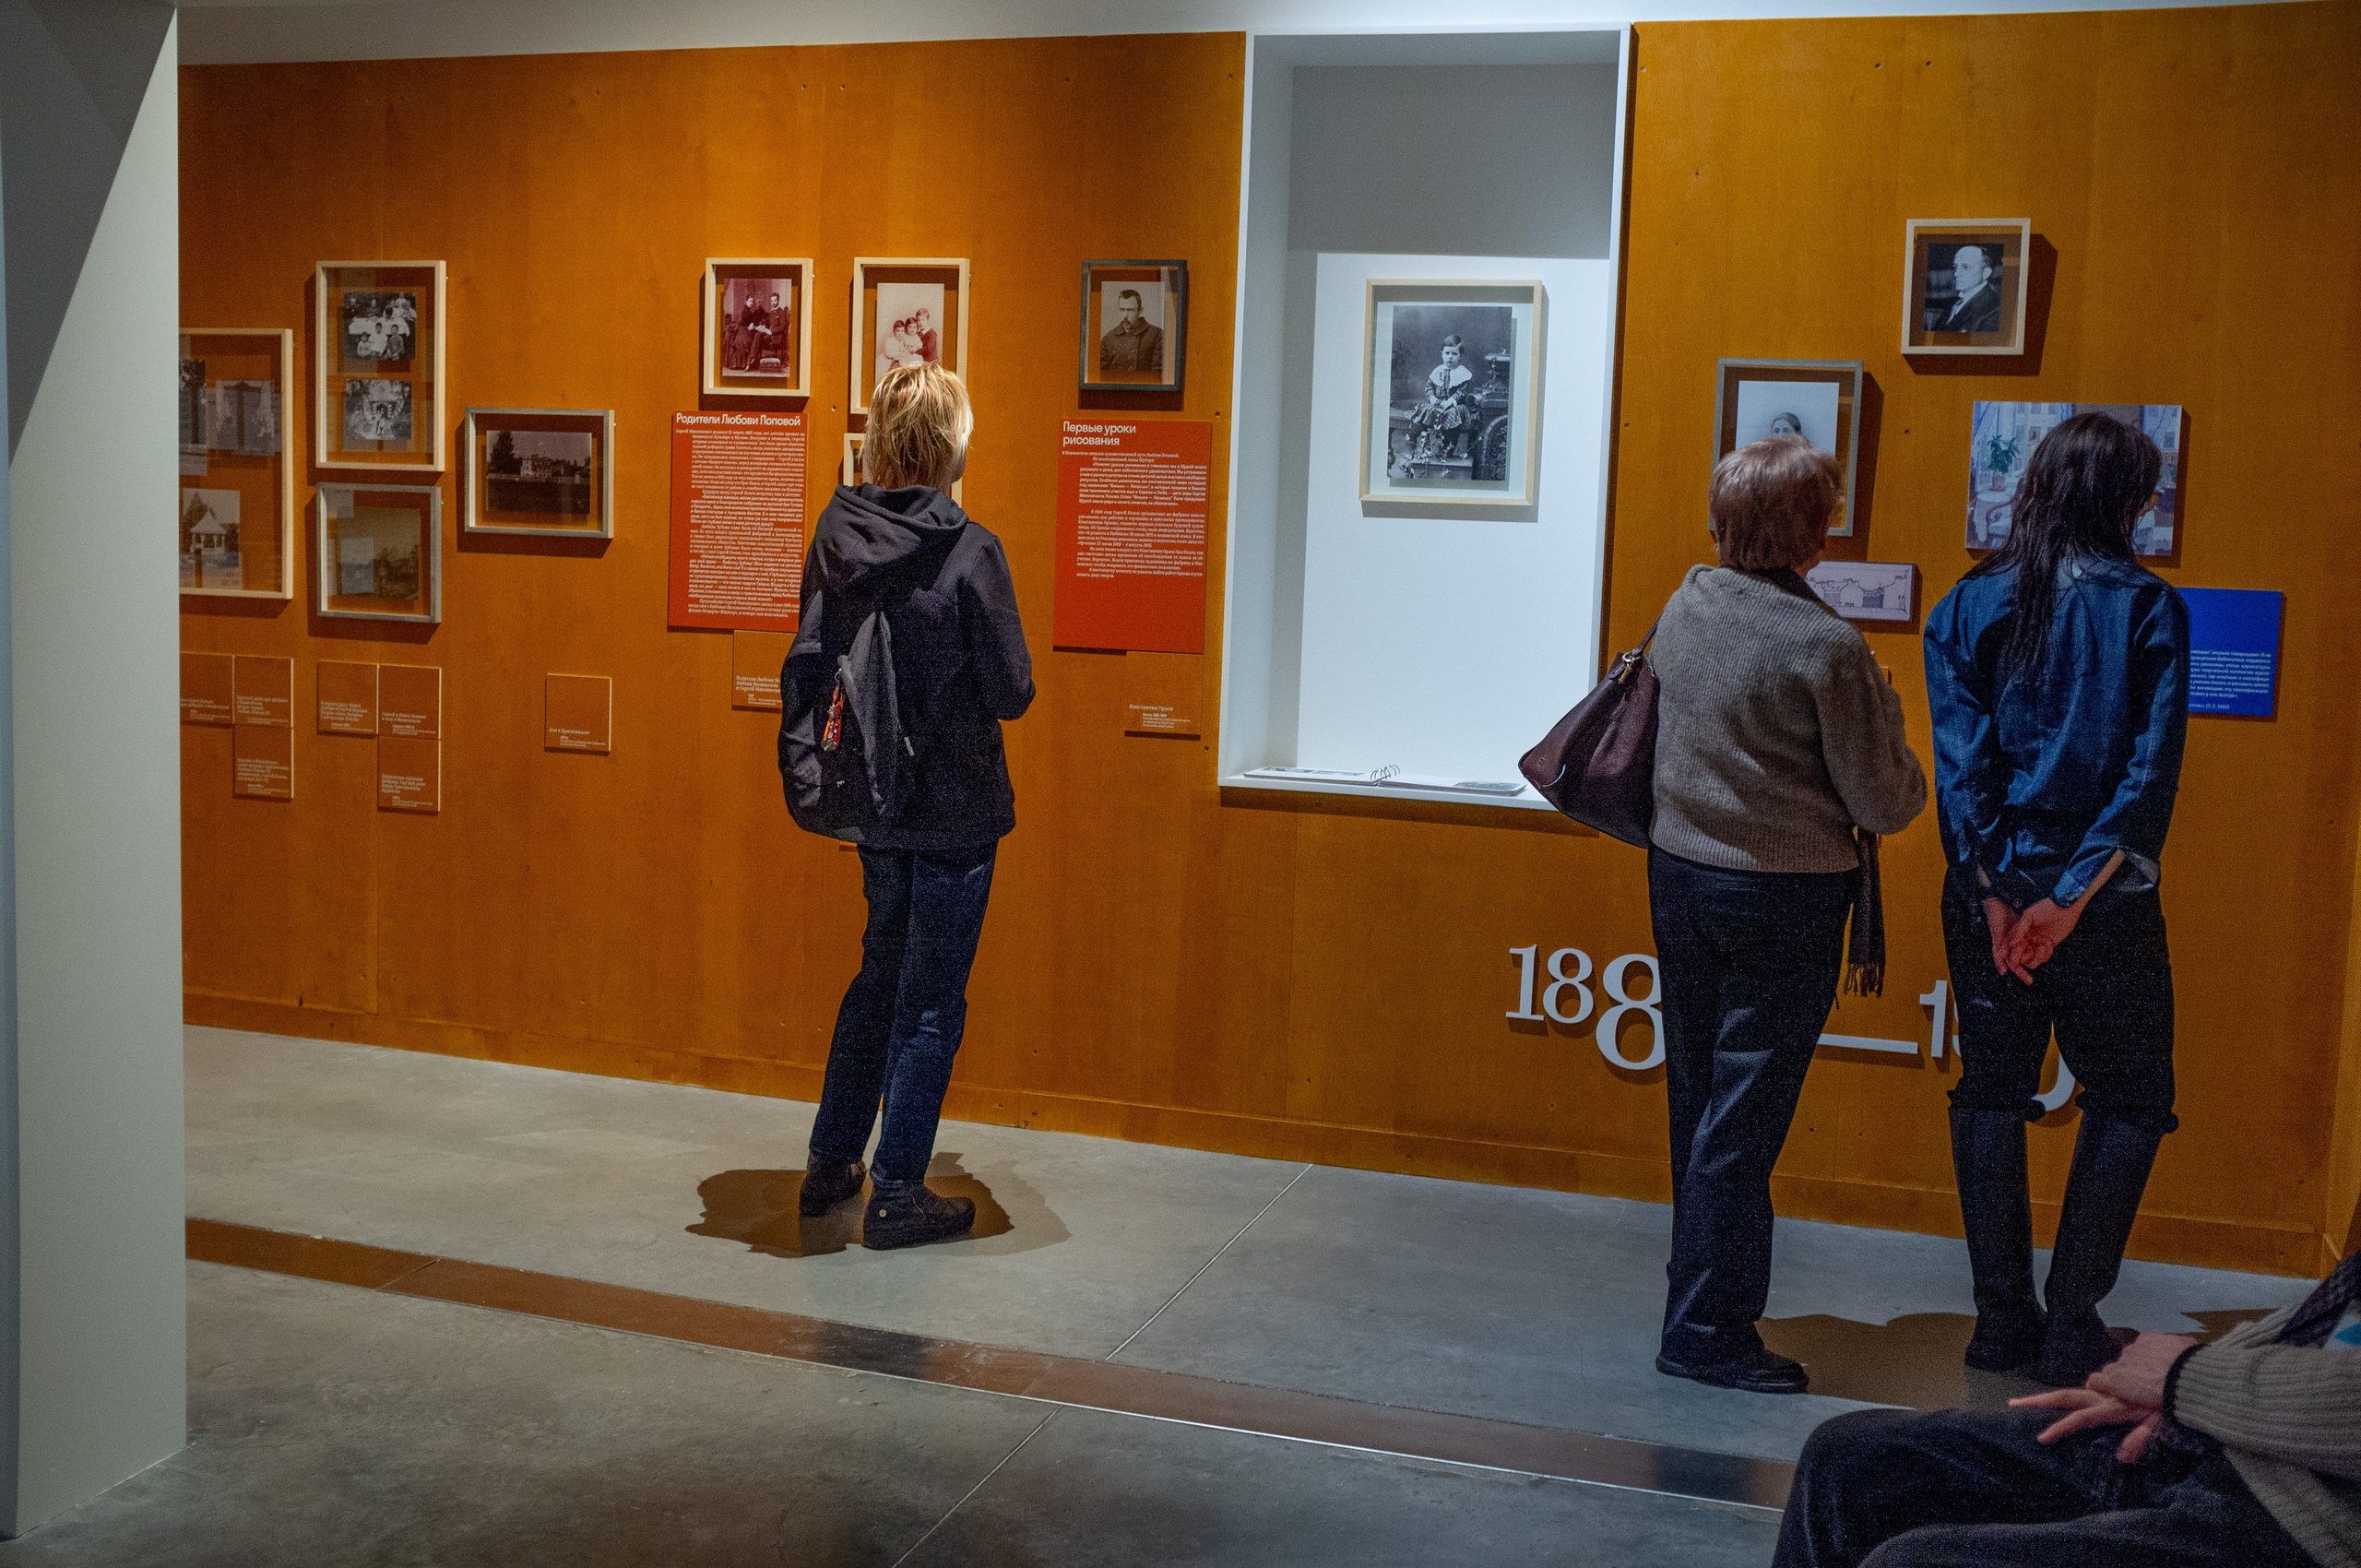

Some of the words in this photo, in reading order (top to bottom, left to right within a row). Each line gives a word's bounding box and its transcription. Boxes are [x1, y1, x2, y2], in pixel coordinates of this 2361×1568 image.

[676, 412, 721, 424] Родители
[721, 413, 759, 425] Любови
[760, 415, 801, 426] Поповой
[1063, 421, 1103, 435] Первые
[1104, 424, 1136, 436] уроки
[1062, 436, 1120, 447] рисования
[1505, 944, 1667, 1070] 188
